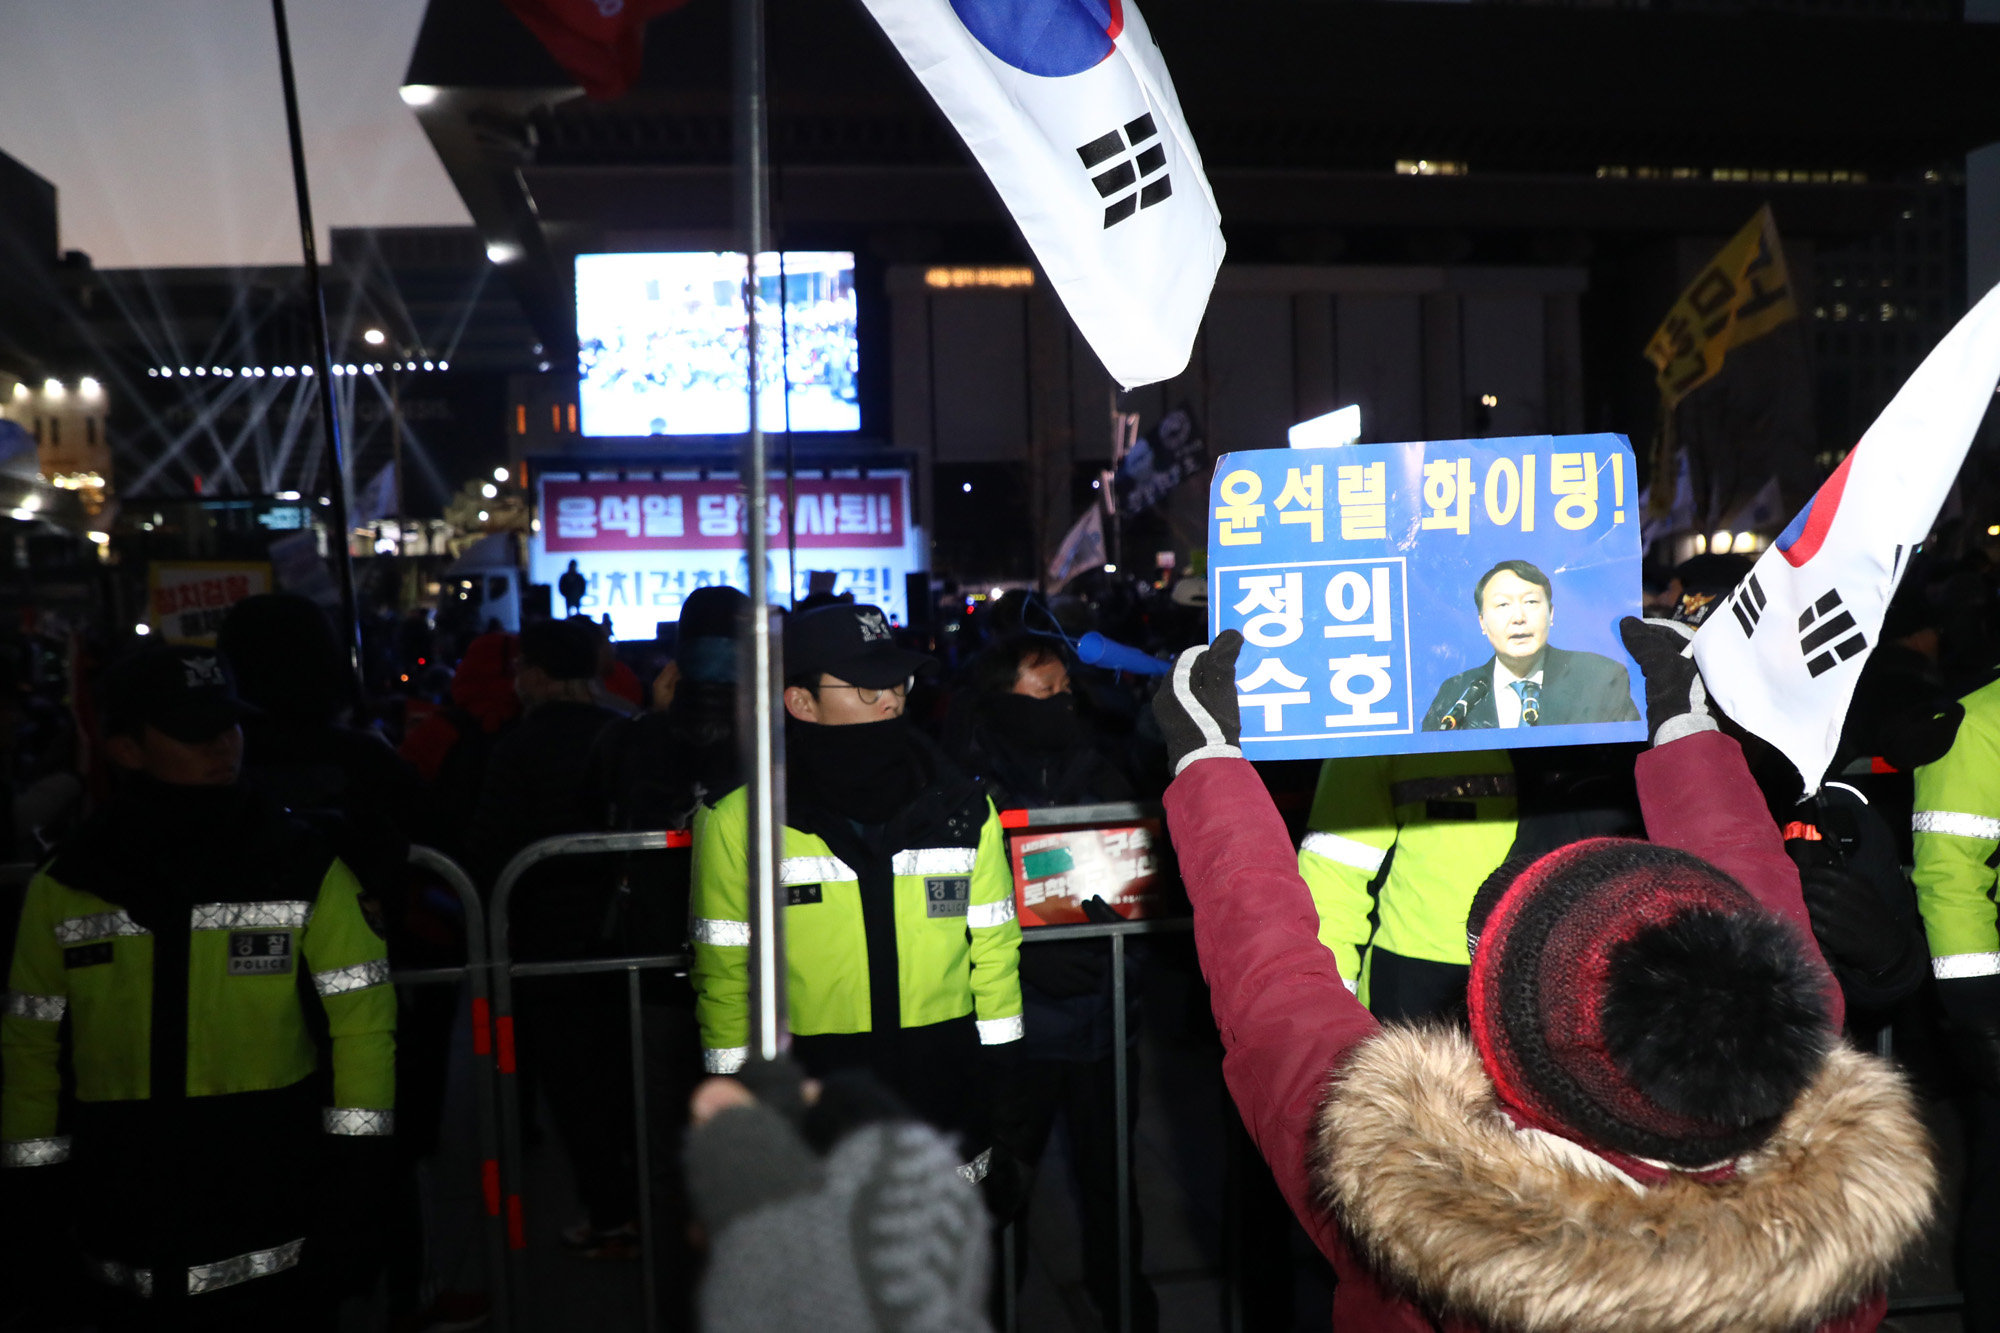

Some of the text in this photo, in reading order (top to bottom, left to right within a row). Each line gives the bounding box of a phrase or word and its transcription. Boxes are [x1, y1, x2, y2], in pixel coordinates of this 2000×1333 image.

[556, 494, 685, 538] 윤석열
[794, 492, 893, 536] 사퇴!
[1215, 460, 1388, 547] 윤석렬
[1421, 451, 1626, 536] 화이팅!
[1233, 566, 1393, 648] 정의
[1236, 652, 1399, 733] 수호
[930, 881, 968, 900] 경찰
[931, 902, 967, 913] POLICE
[234, 935, 286, 957] 경찰
[233, 959, 286, 970] POLICE
